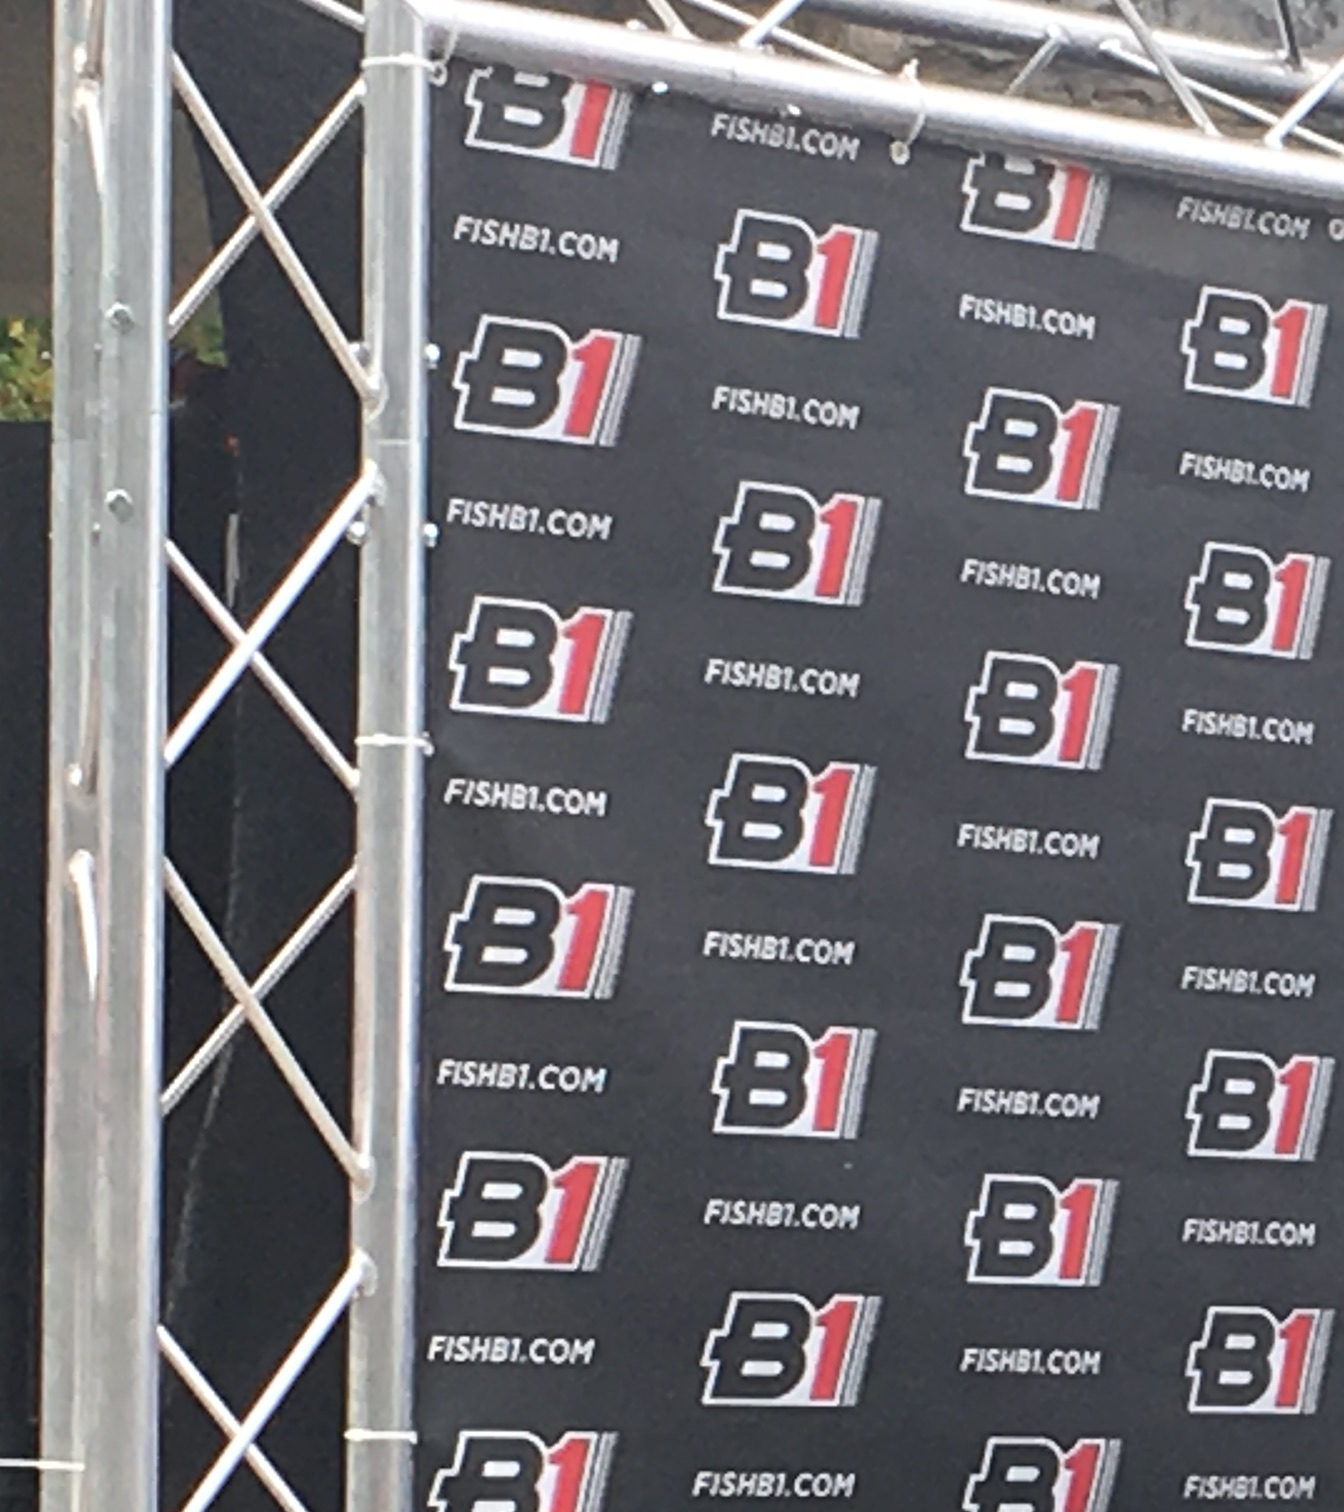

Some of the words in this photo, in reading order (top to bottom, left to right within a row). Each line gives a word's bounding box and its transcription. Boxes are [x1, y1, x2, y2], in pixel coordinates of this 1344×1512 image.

[712, 115, 859, 160] FISHB1.COM
[455, 217, 619, 262] FISHB1.COM
[1178, 198, 1309, 240] FISHB1.COM
[714, 209, 878, 338] B1
[959, 294, 1095, 339] FISHB1.COM
[1181, 286, 1327, 407] B1
[453, 313, 642, 448] B1
[712, 386, 859, 429] FISHB1.COM
[963, 387, 1120, 509] B1
[1180, 452, 1310, 492] FISHB1.COM
[448, 499, 612, 539] FISHB1.COM
[712, 481, 881, 606] B1
[961, 559, 1100, 599] FISHB1.COM
[1185, 541, 1330, 659] B1
[450, 596, 633, 724] B1
[704, 659, 860, 697] FISHB1.COM
[964, 650, 1119, 770] B1
[1182, 709, 1314, 744] FISHB1.COM
[445, 780, 607, 816] FISHB1.COM
[705, 753, 877, 874] B1
[957, 824, 1100, 859] FISHB1.COM
[1185, 797, 1333, 912] B1
[445, 875, 634, 999] B1
[703, 931, 855, 965] FISHB1.COM
[959, 914, 1120, 1030] B1
[1181, 966, 1315, 997] FISHB1.COM
[439, 1060, 607, 1093] FISHB1.COM
[711, 1020, 877, 1139] B1
[957, 1088, 1100, 1118] FISHB1.COM
[1185, 1049, 1335, 1161] B1
[438, 1151, 628, 1271] B1
[704, 1199, 860, 1229] FISHB1.COM
[964, 1173, 1119, 1287] B1
[1182, 1219, 1315, 1246] FISHB1.COM
[429, 1337, 595, 1364] FISHB1.COM
[700, 1291, 881, 1407] B1
[960, 1348, 1101, 1374] FISHB1.COM
[1185, 1306, 1335, 1414] B1
[692, 1471, 855, 1497] FISHB1.COM
[1184, 1475, 1315, 1499] FISHB1.COM
